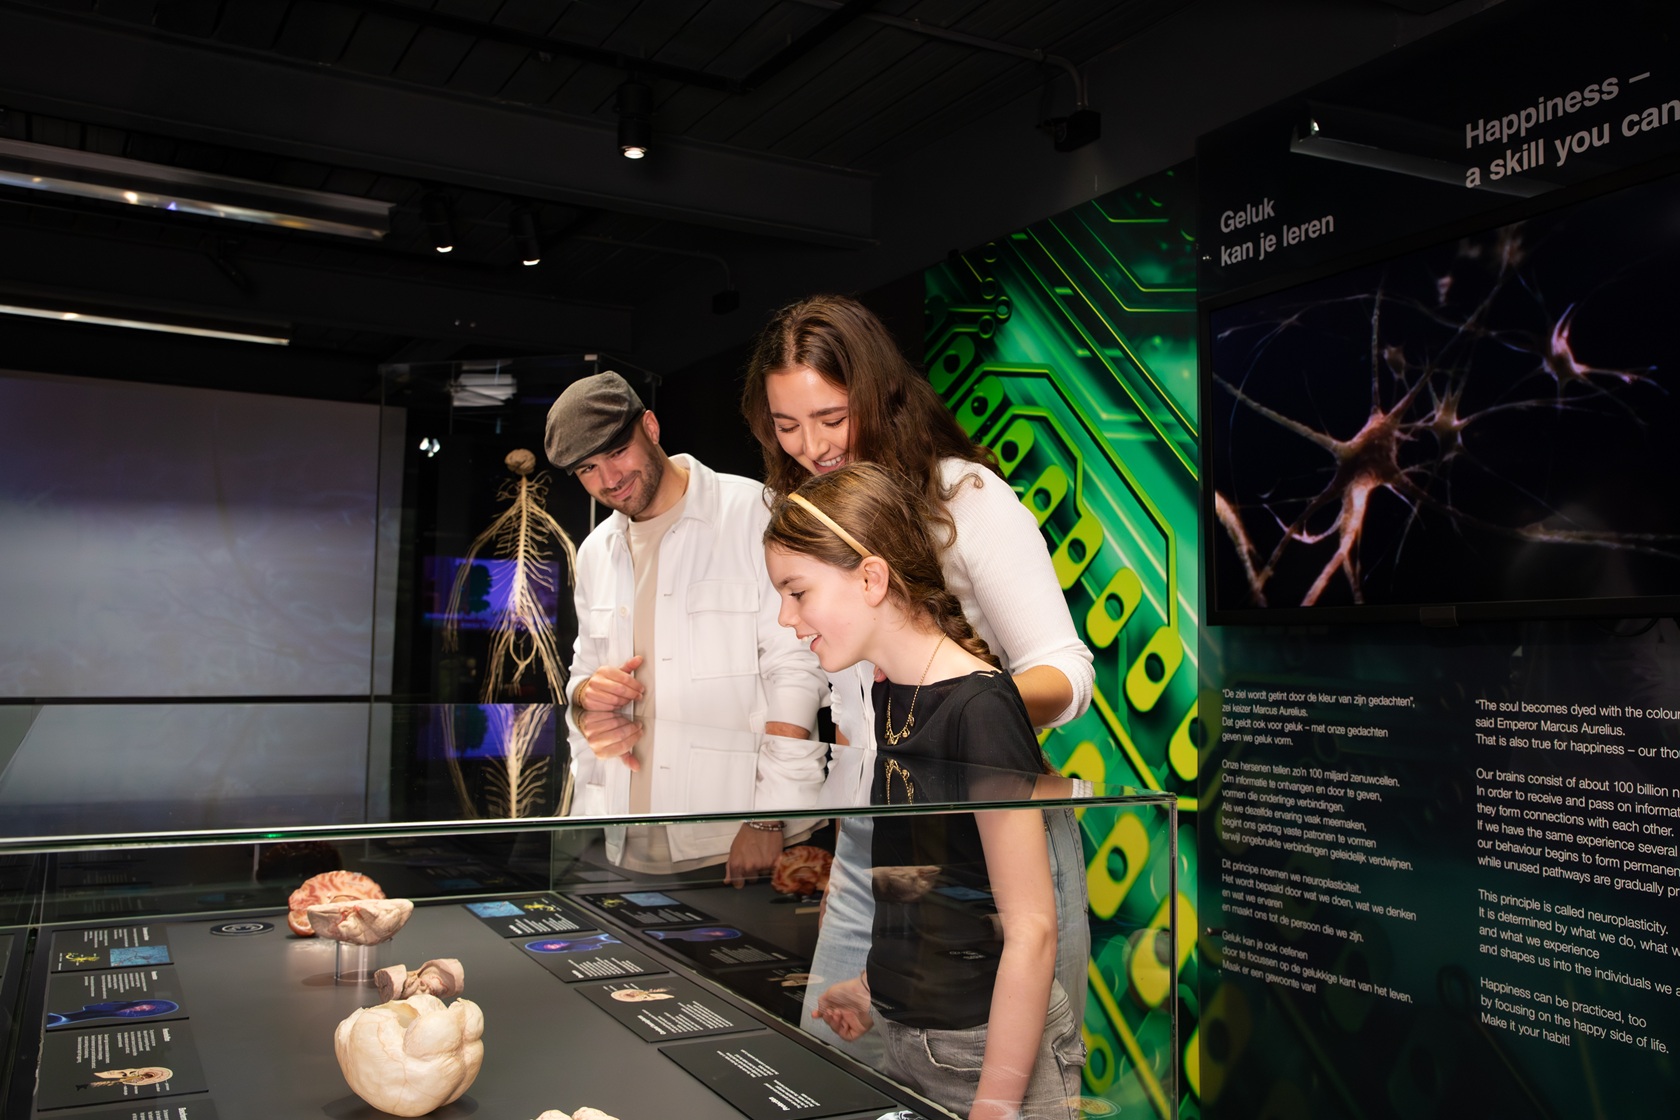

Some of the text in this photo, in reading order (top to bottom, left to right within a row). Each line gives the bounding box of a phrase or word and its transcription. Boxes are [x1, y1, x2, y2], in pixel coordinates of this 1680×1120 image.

[1466, 77, 1619, 149] Happiness
[1465, 99, 1680, 189] a skill you can
[1220, 198, 1275, 233] Geluk
[1221, 215, 1334, 267] kan je leren
[1221, 704, 1309, 717] zei keizer Marcus Aurelius.
[1235, 690, 1246, 699] ziel
[1247, 691, 1267, 700] wordt
[1268, 691, 1287, 702] getint
[1288, 692, 1306, 702] door
[1307, 693, 1317, 703] de
[1318, 693, 1337, 703] kleur
[1338, 695, 1352, 704] van
[1353, 695, 1367, 707] zijn
[1499, 701, 1519, 712] soul
[1522, 701, 1568, 715] becomes
[1571, 704, 1596, 718] dyed
[1599, 705, 1622, 717] with
[1625, 706, 1643, 718] the
[1475, 717, 1626, 736] said Emperor Marcus Aurelius.
[1475, 733, 1496, 745] That
[1499, 737, 1507, 747] is
[1509, 736, 1529, 748] also
[1531, 738, 1551, 750] true
[1553, 739, 1568, 751] for
[1570, 740, 1625, 755] happiness
[1638, 747, 1657, 757] our
[1660, 746, 1680, 759] tho
[1222, 759, 1239, 770] Onze
[1240, 761, 1271, 773] hersenen
[1272, 765, 1291, 775] tellen
[1309, 768, 1323, 779] 100
[1324, 770, 1349, 783] miljard
[1350, 774, 1400, 787] zenuwcellen.
[1476, 768, 1493, 780] Our
[1496, 770, 1525, 783] brains
[1528, 775, 1563, 787] consist
[1566, 777, 1576, 788] of
[1579, 778, 1609, 792] about
[1614, 781, 1634, 794] 100
[1637, 783, 1669, 797] billion
[1476, 785, 1485, 796] In
[1487, 788, 1513, 799] order
[1515, 790, 1525, 801] to
[1527, 793, 1563, 805] receive
[1565, 796, 1585, 808] and
[1588, 799, 1614, 811] pass
[1617, 802, 1632, 813] on
[1476, 803, 1674, 837] they form connections with each other.
[1476, 820, 1678, 857] If we have the same experience several
[1477, 839, 1493, 849] our
[1495, 839, 1542, 856] behaviour
[1545, 846, 1579, 863] begins
[1582, 852, 1592, 864] to
[1595, 854, 1620, 868] form
[1478, 855, 1501, 868] while
[1504, 861, 1539, 874] unused
[1542, 866, 1591, 884] pathways
[1593, 874, 1611, 886] are
[1614, 878, 1664, 897] gradually
[1222, 873, 1417, 921] Het wordt bepaald door wat we doen, wat we denken
[1477, 888, 1669, 937] This principle is called neuroplasticity.
[1222, 930, 1308, 960] Geluk kan je ook oefenen
[1478, 907, 1485, 918] It
[1487, 910, 1496, 920] is
[1497, 911, 1553, 931] determined
[1554, 921, 1568, 936] by
[1569, 926, 1597, 940] what
[1598, 932, 1616, 944] we
[1618, 934, 1637, 950] do,
[1639, 940, 1669, 955] what
[1478, 926, 1600, 960] and what we experience
[1479, 944, 1498, 956] and
[1500, 947, 1536, 964] shapes
[1538, 957, 1551, 968] us
[1553, 957, 1572, 972] into
[1574, 963, 1592, 977] the
[1594, 969, 1652, 990] individuals
[1654, 982, 1672, 995] we
[1480, 977, 1647, 1028] Happiness can be practiced, too
[1481, 994, 1669, 1054] by focusing on the happy side of life.
[1481, 1012, 1571, 1046] Make it your habit!
